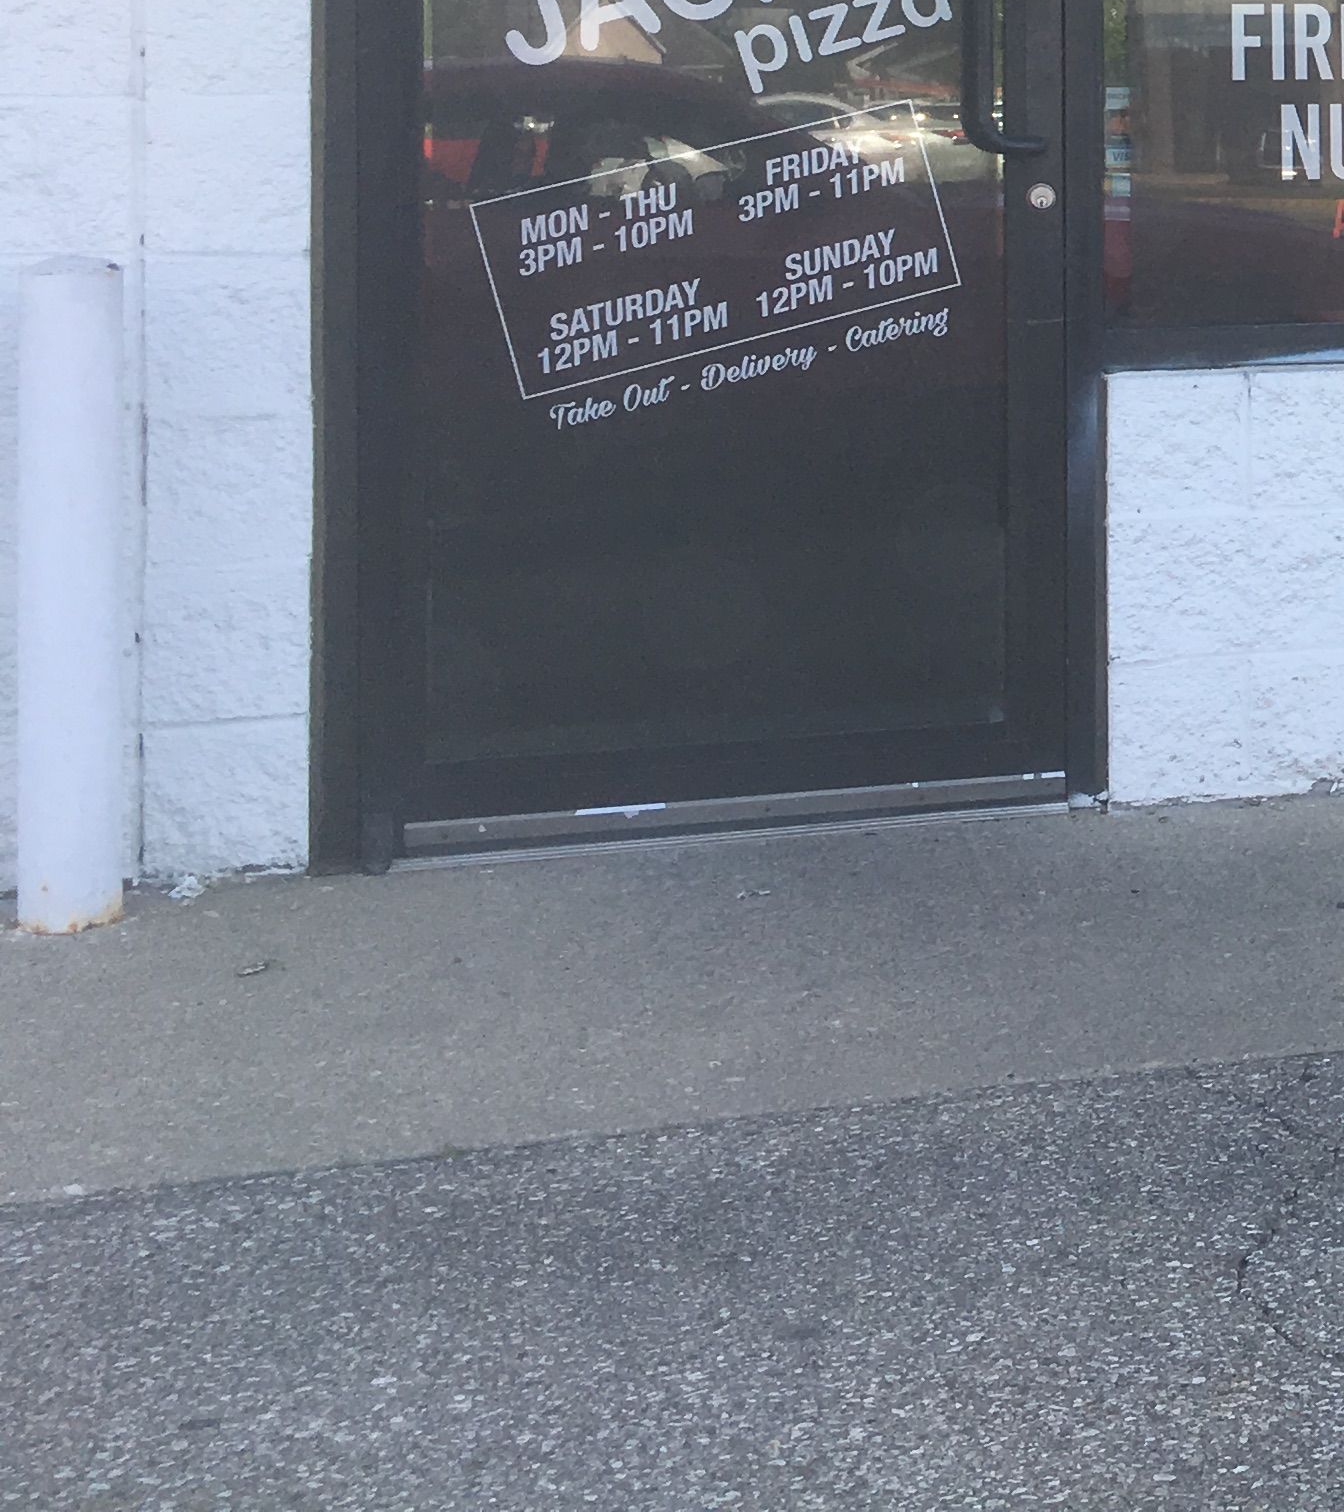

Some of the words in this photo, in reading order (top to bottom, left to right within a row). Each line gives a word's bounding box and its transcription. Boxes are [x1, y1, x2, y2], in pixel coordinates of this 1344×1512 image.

[738, 190, 800, 223] 3PM
[829, 158, 906, 199] 11PM
[765, 138, 863, 185] FRIDAY
[519, 237, 583, 277] 3PM
[613, 209, 694, 253] 10PM
[520, 204, 589, 245] MON
[619, 183, 677, 223] THU
[756, 276, 833, 319] 12PM
[863, 248, 939, 290] 10PM
[784, 229, 896, 281] SUNDAY
[537, 330, 618, 375] 12PM
[649, 302, 728, 345] 11PM
[550, 278, 701, 341] SATURDAY
[549, 394, 615, 430] Take
[623, 376, 675, 412] Out
[700, 346, 816, 393] Delivery
[845, 306, 951, 353] Catering
